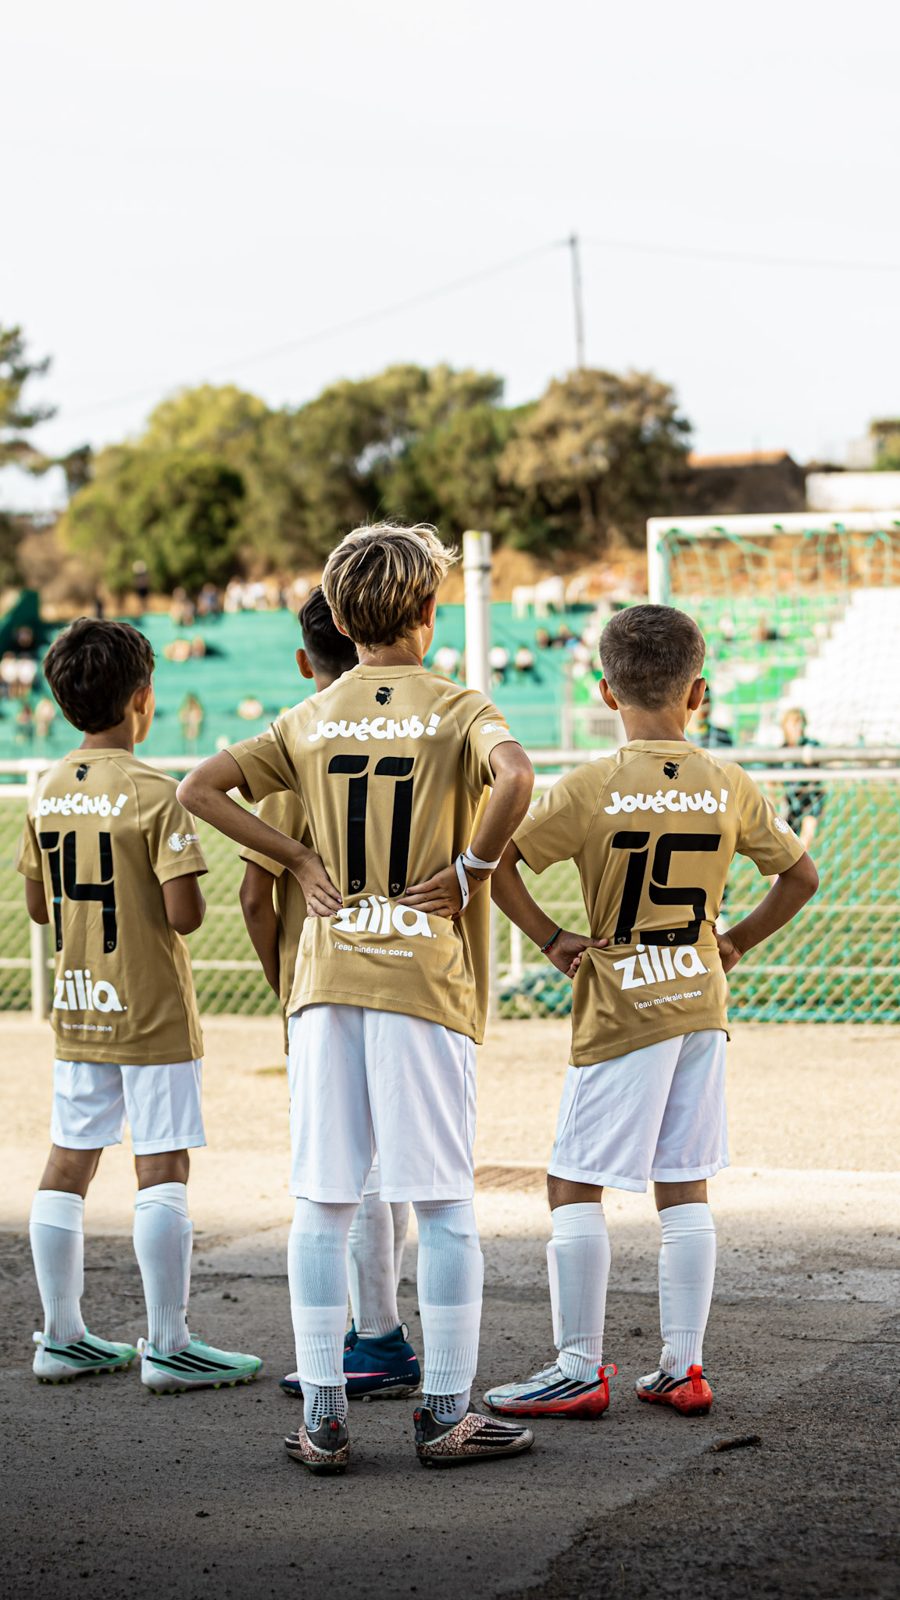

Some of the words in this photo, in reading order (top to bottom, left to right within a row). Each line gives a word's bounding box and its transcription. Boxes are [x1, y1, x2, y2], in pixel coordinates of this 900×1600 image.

[308, 713, 441, 742] JouéClub!
[328, 754, 415, 898] 11
[604, 788, 729, 815] JouéClub!
[38, 830, 118, 954] 14
[611, 830, 722, 946] 15
[388, 948, 414, 958] corse
